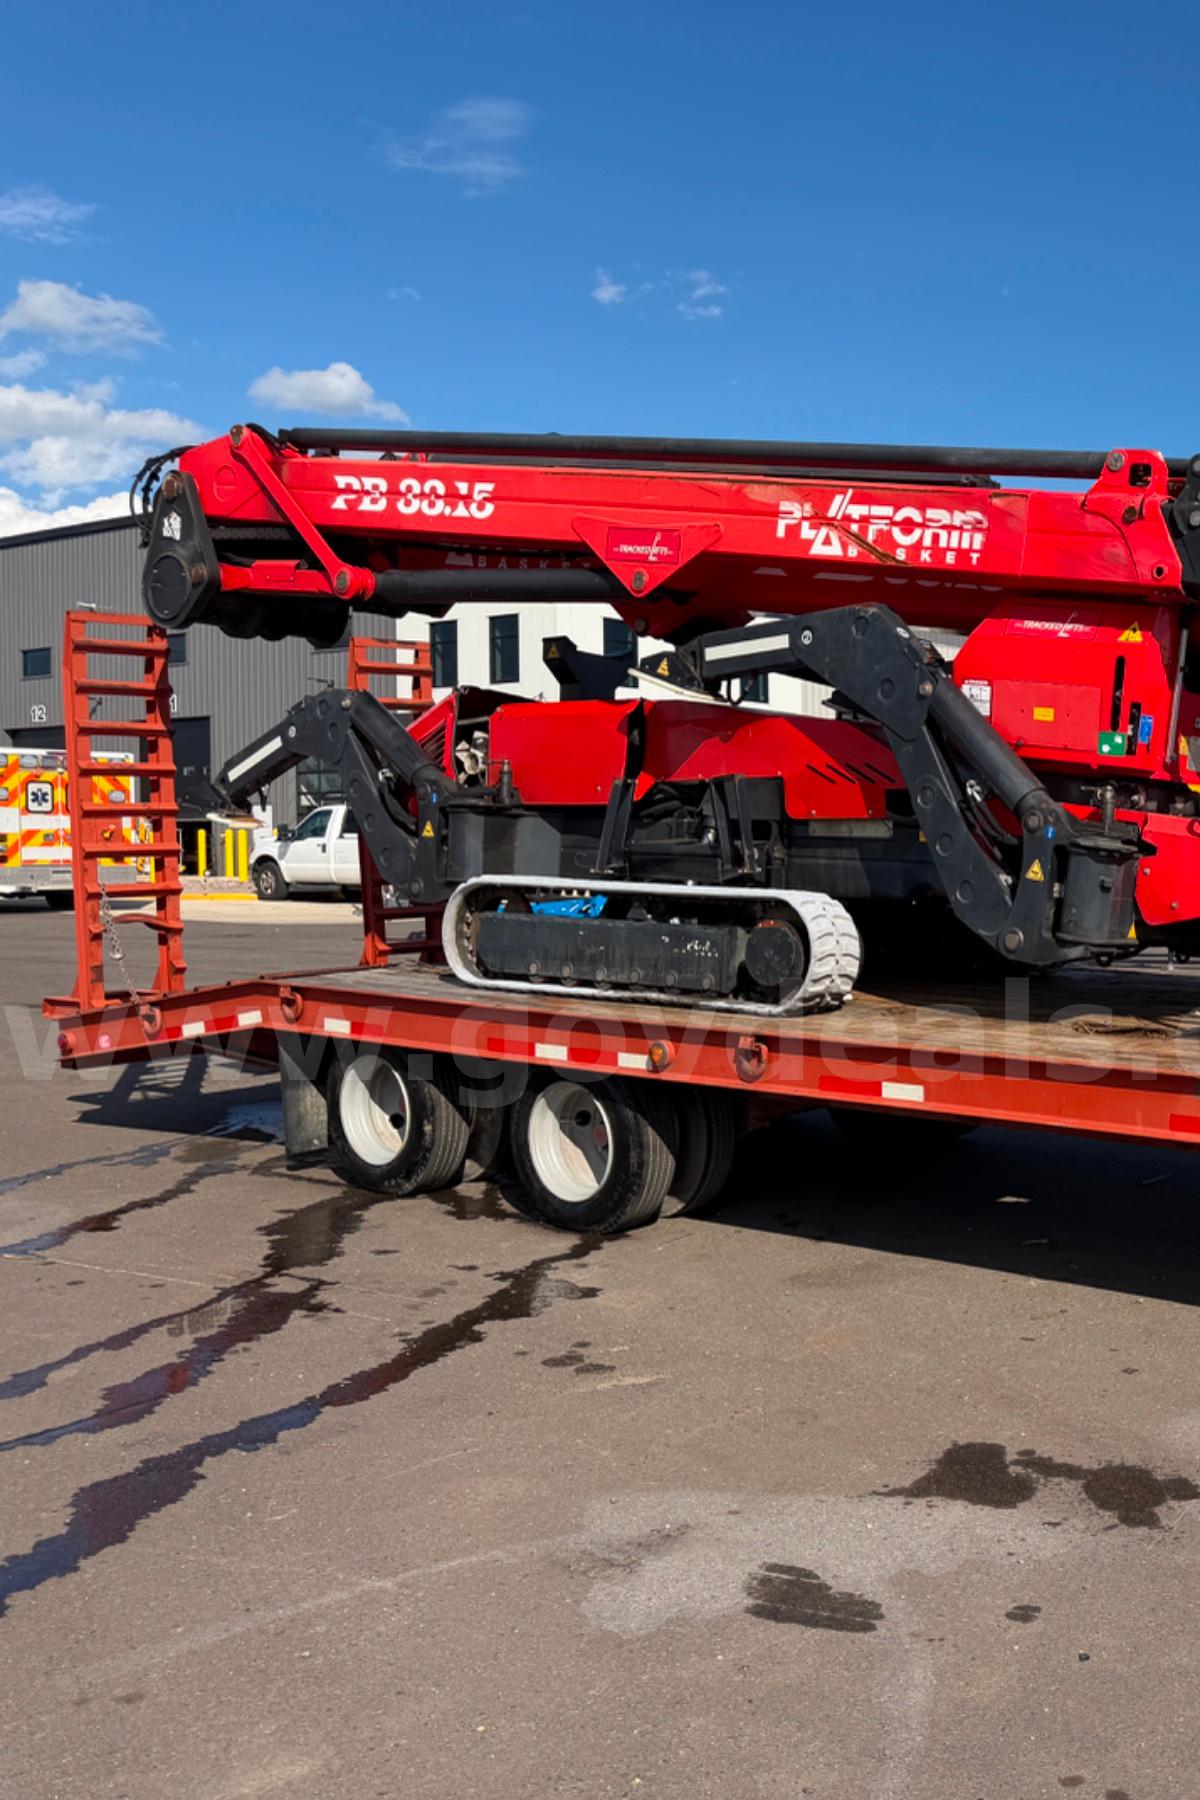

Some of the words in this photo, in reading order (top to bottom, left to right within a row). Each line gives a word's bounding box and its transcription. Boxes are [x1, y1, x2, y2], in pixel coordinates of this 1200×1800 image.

[331, 475, 388, 511] PB
[776, 488, 989, 556] PLATFORM
[847, 547, 981, 566] BSKET
[31, 704, 47, 723] 12
